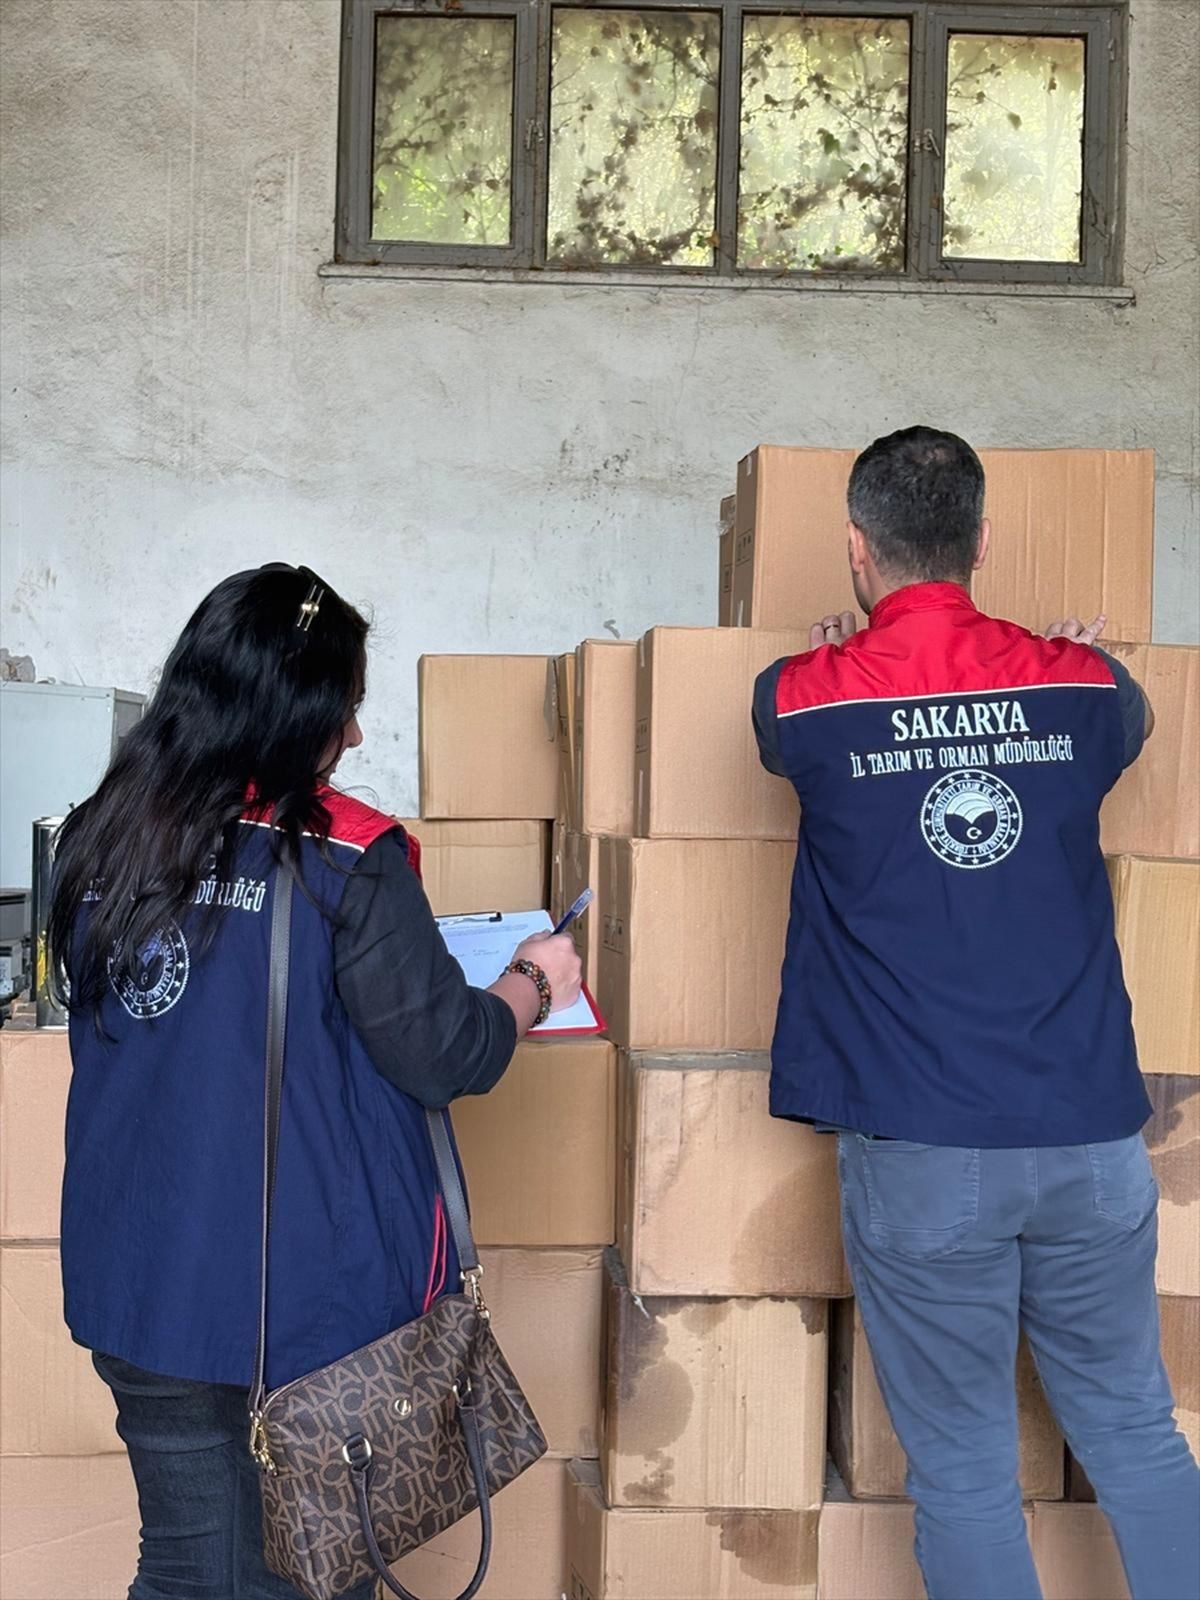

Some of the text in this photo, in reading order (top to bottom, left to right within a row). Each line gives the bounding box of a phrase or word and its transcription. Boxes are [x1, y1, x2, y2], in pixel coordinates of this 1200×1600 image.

[891, 701, 1030, 741] SAKARYA
[850, 735, 1074, 778] İL TARIM VE ORMAN MÜDÜRLÜĞÜ
[193, 874, 266, 912] DÜLÜĞÜ
